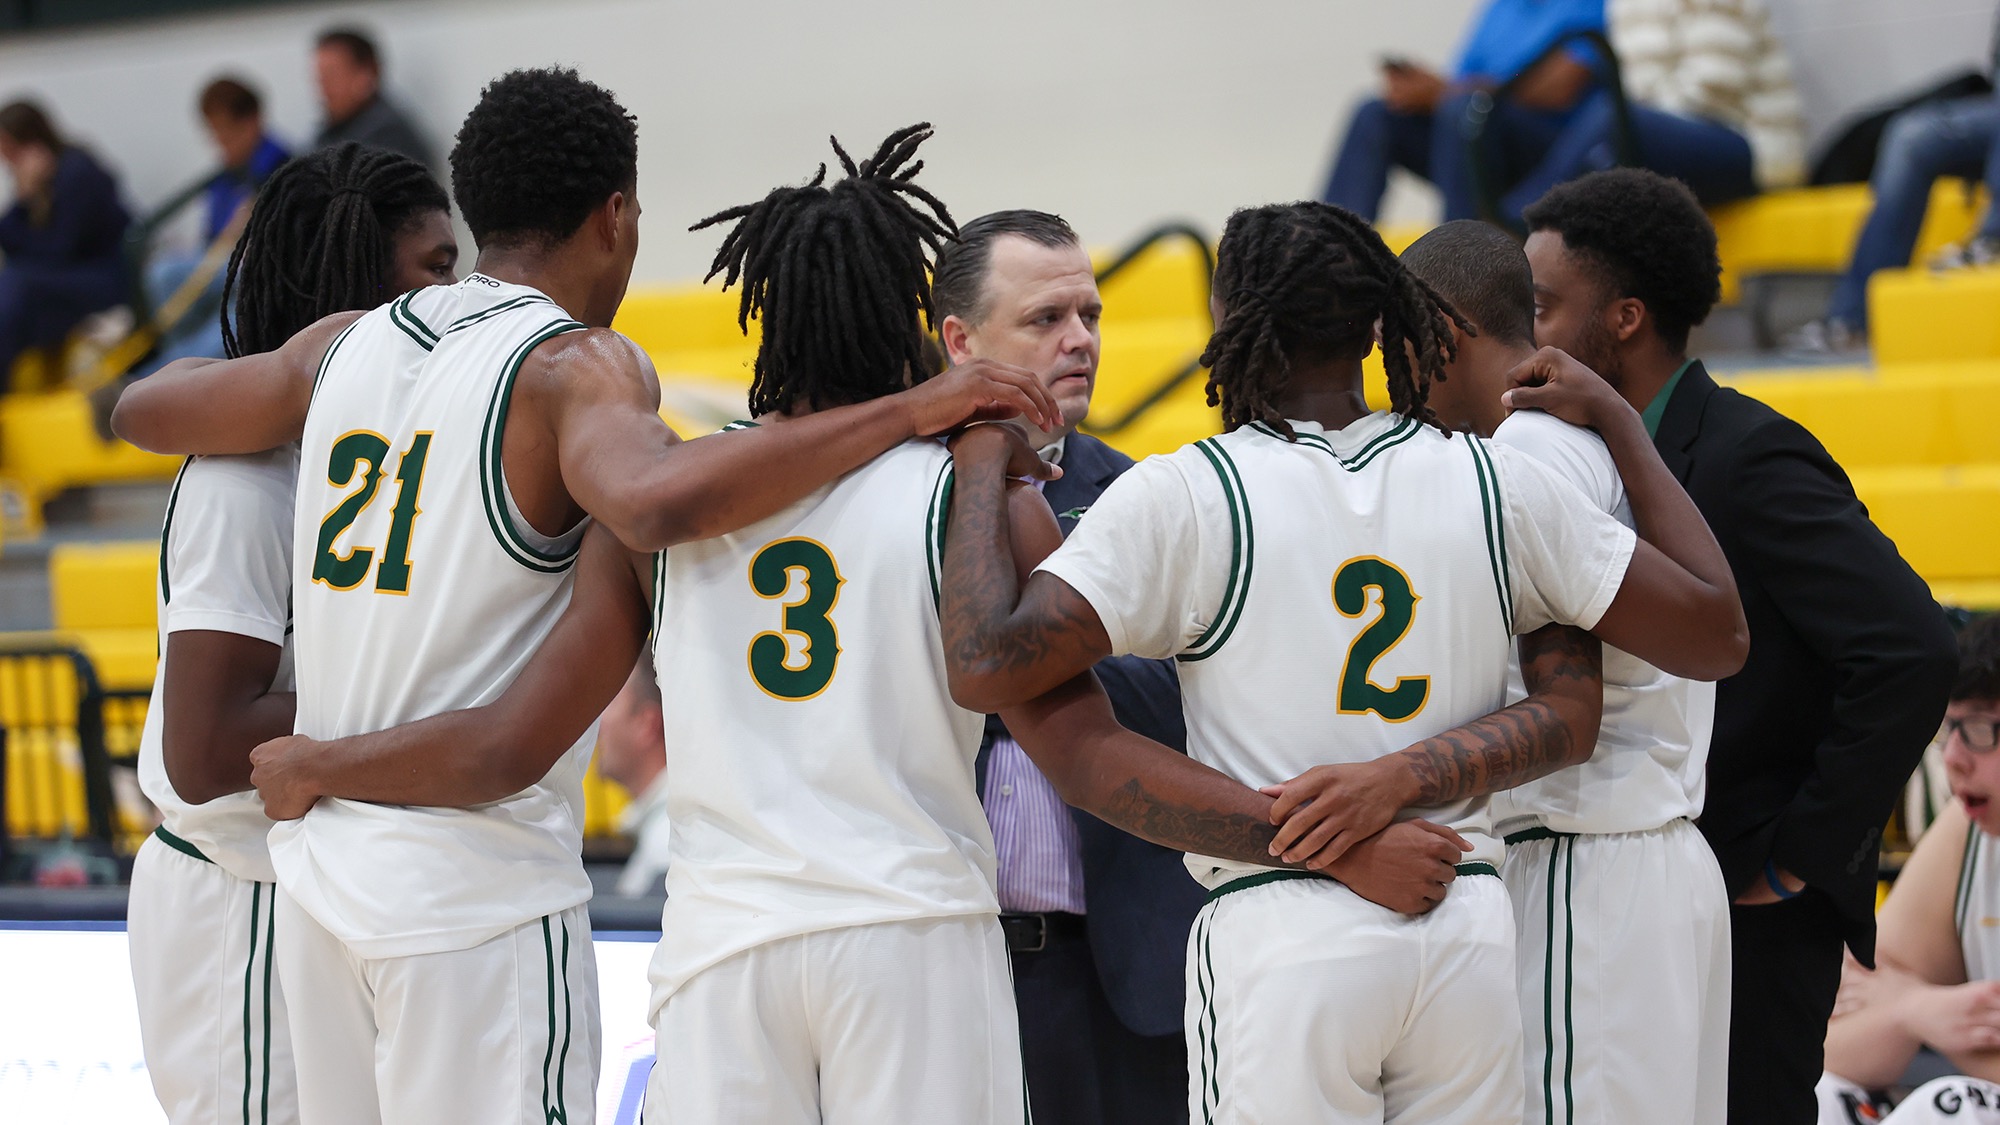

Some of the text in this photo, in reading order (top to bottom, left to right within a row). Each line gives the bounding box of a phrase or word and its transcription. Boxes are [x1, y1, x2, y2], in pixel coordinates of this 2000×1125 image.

[311, 429, 434, 596] 21
[747, 536, 848, 702] 3
[1331, 554, 1431, 724] 2
